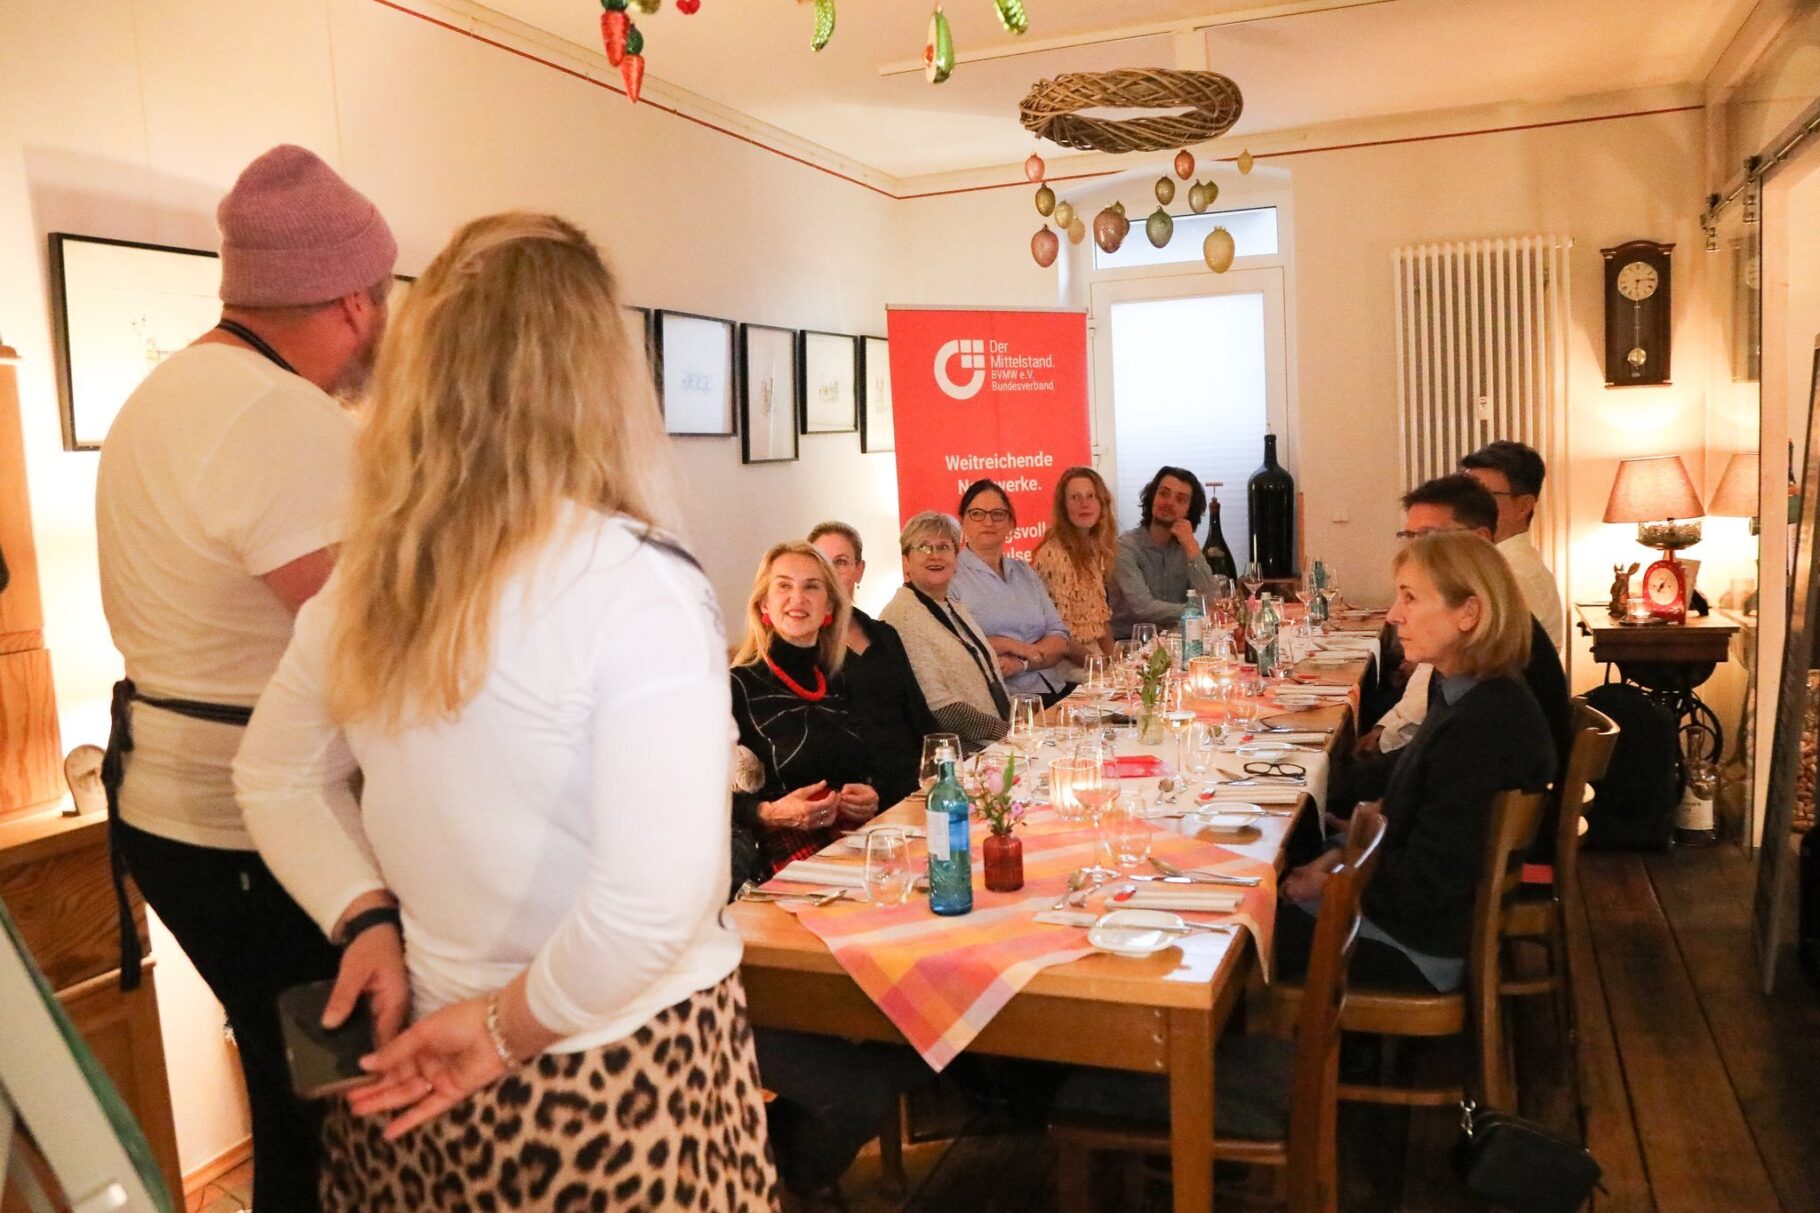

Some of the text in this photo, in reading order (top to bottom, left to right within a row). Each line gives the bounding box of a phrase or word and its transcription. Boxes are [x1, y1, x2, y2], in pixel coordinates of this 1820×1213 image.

[989, 339, 1008, 353] Der
[991, 370, 1017, 380] BVMW
[992, 381, 1053, 391] Bundesverband
[945, 451, 1053, 471] Weitreichende
[958, 476, 1042, 495] Nwerke.
